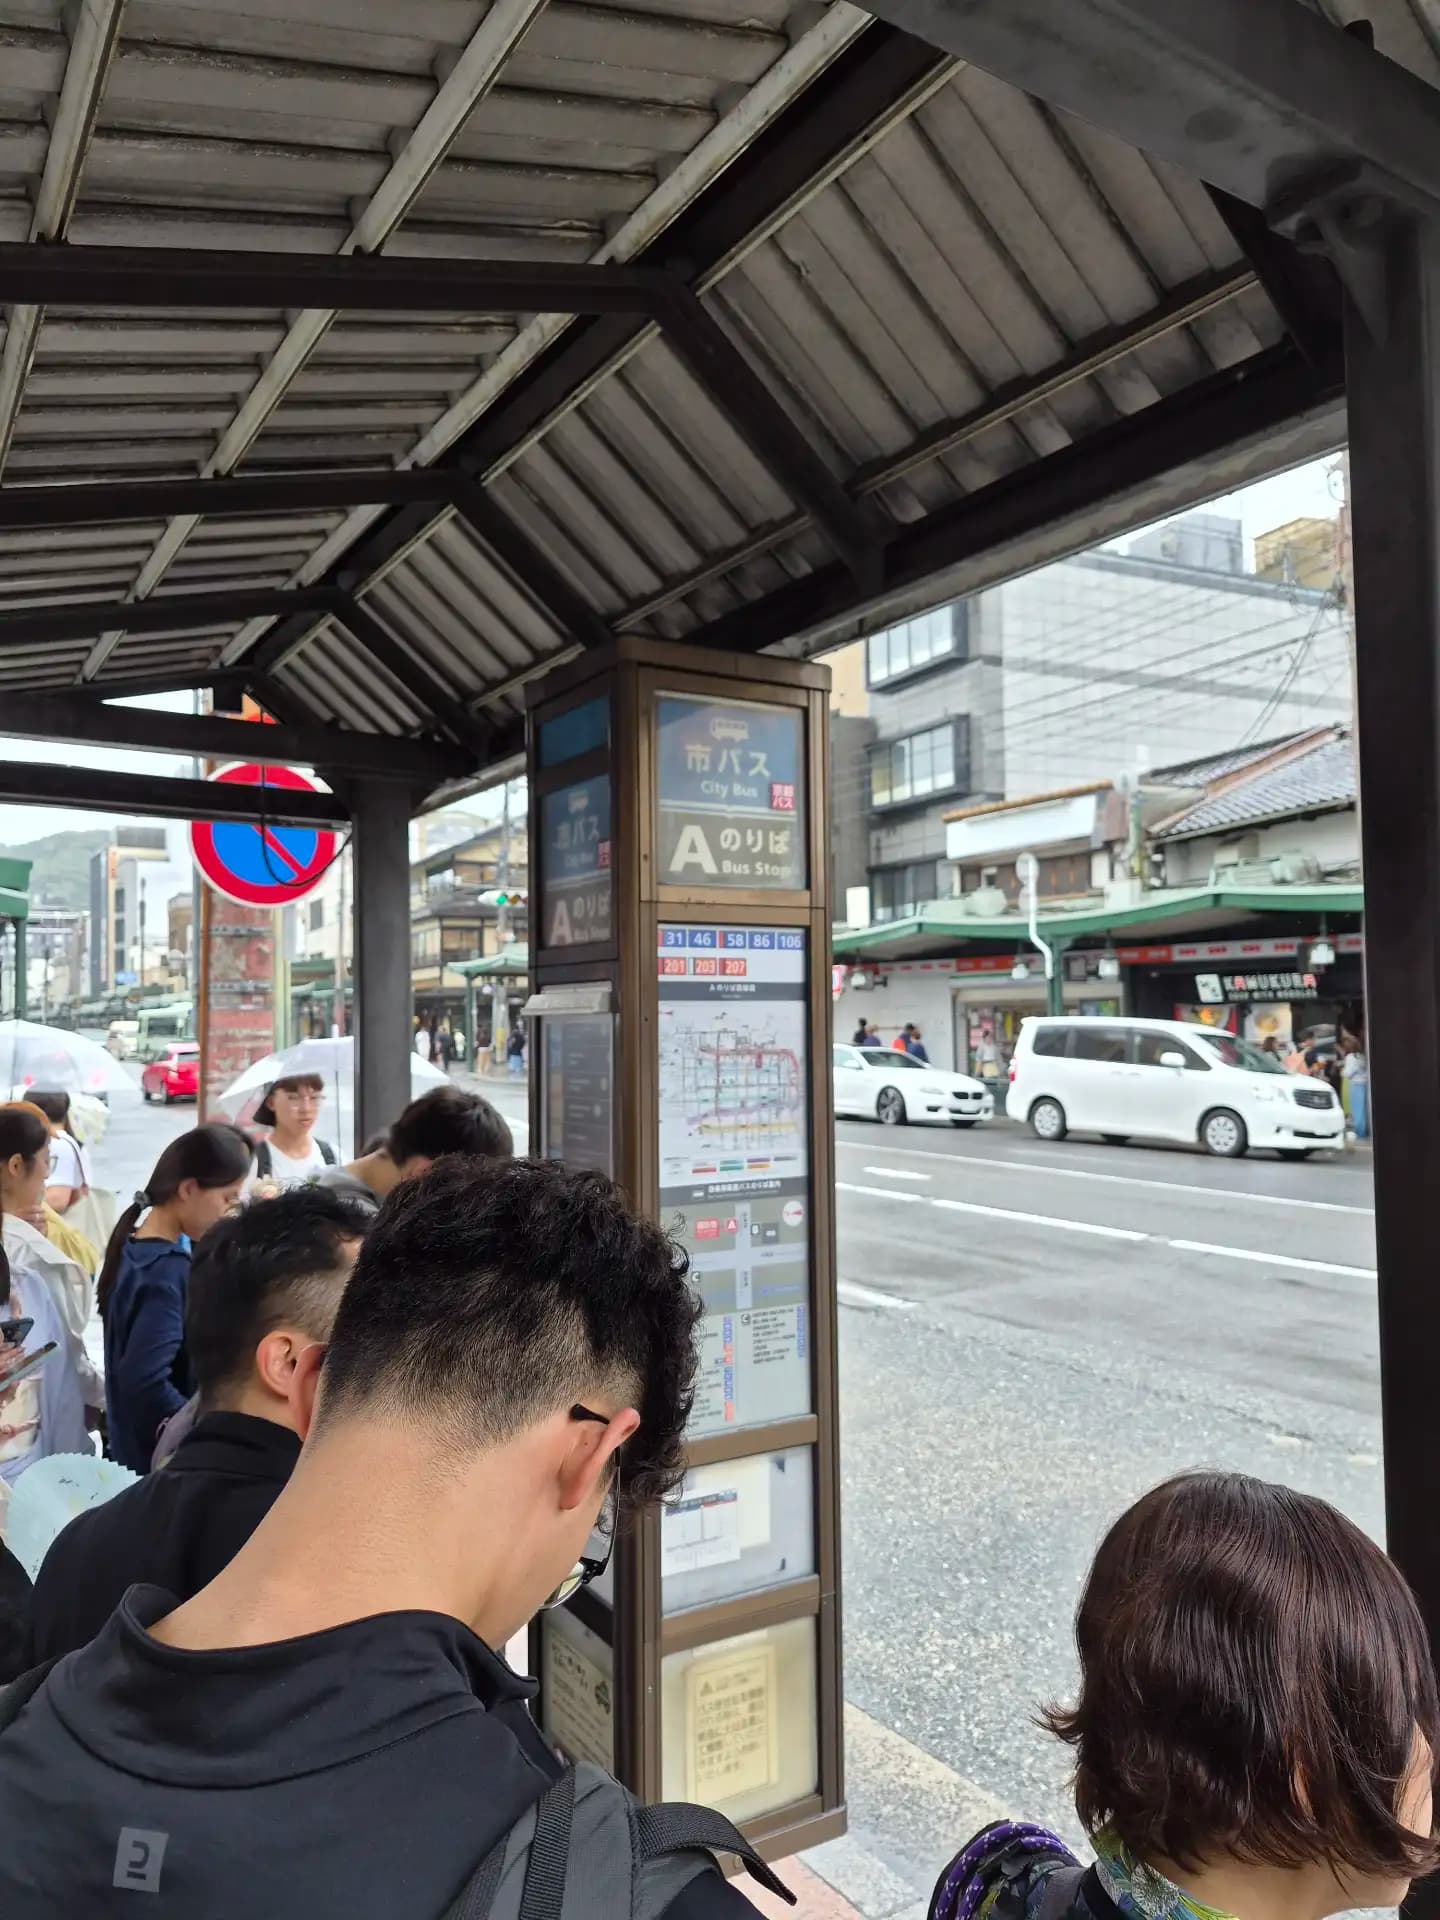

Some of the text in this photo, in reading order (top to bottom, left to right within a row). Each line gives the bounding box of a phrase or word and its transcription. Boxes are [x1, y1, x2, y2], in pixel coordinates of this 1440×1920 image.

[684, 744, 771, 778] 市バス
[701, 780, 758, 798] City Bus
[669, 824, 790, 874] A のりば
[722, 860, 792, 879] Bus Stop
[550, 900, 573, 946] A
[666, 932, 802, 949] 31 46 58 86 106
[663, 959, 745, 974] 201 203 207
